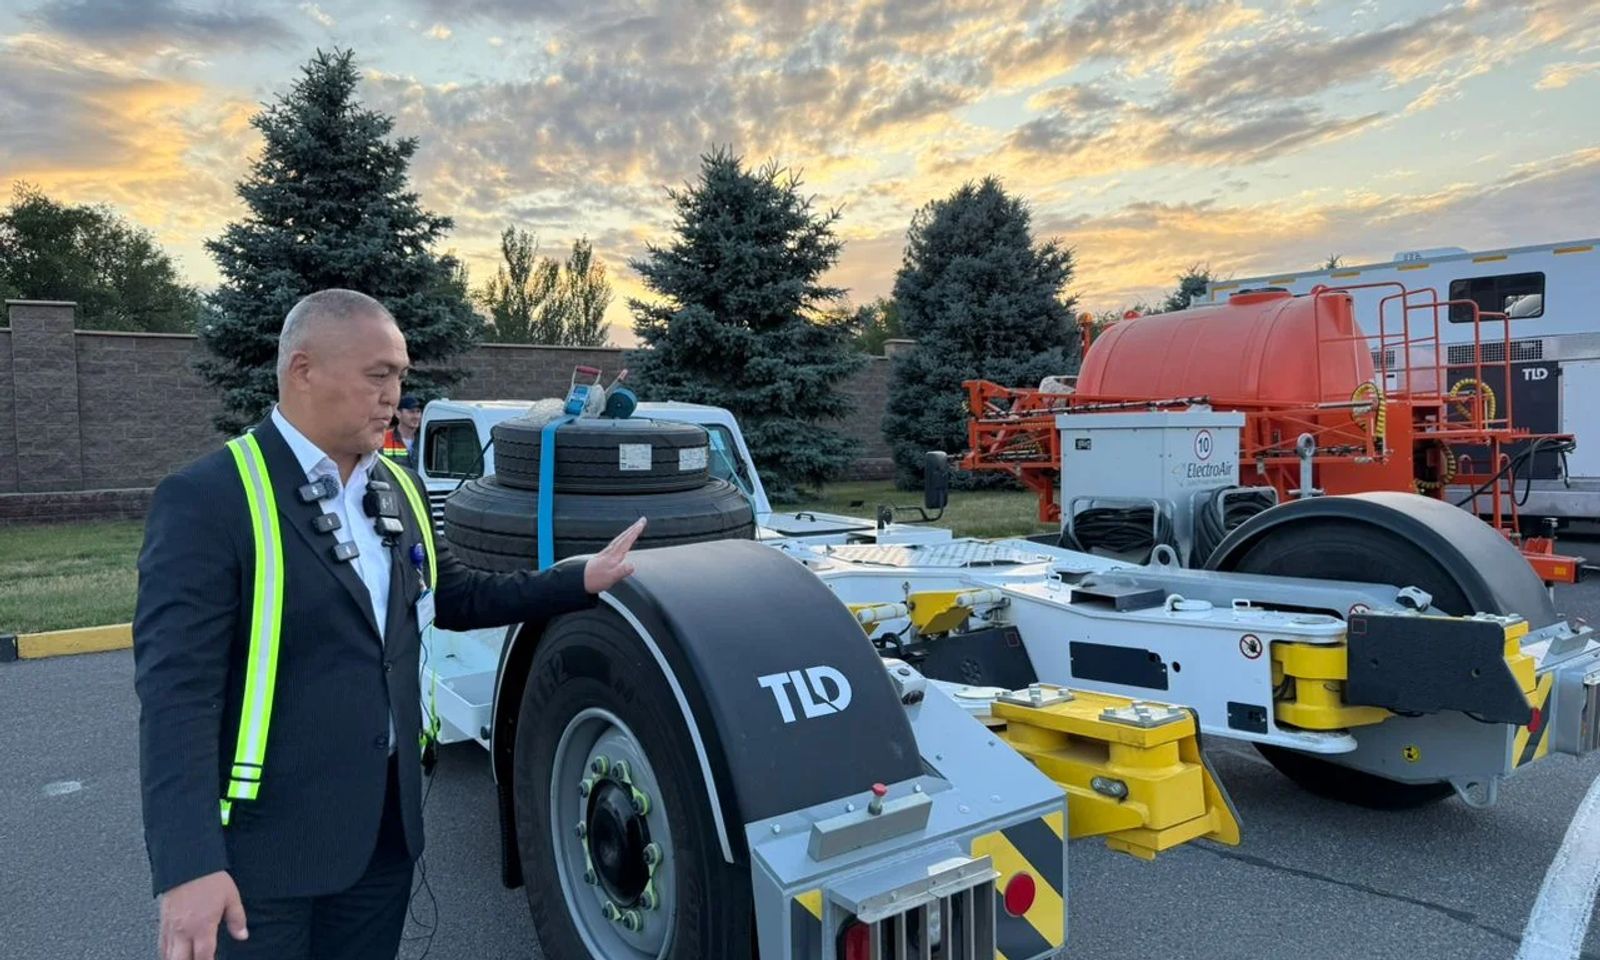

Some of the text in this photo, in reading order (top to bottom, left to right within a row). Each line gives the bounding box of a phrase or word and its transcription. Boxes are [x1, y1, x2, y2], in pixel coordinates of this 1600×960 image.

[1521, 367, 1549, 381] TLD
[1198, 437, 1210, 453] 10
[1186, 461, 1233, 478] ElectroAir
[757, 665, 852, 723] TLD
